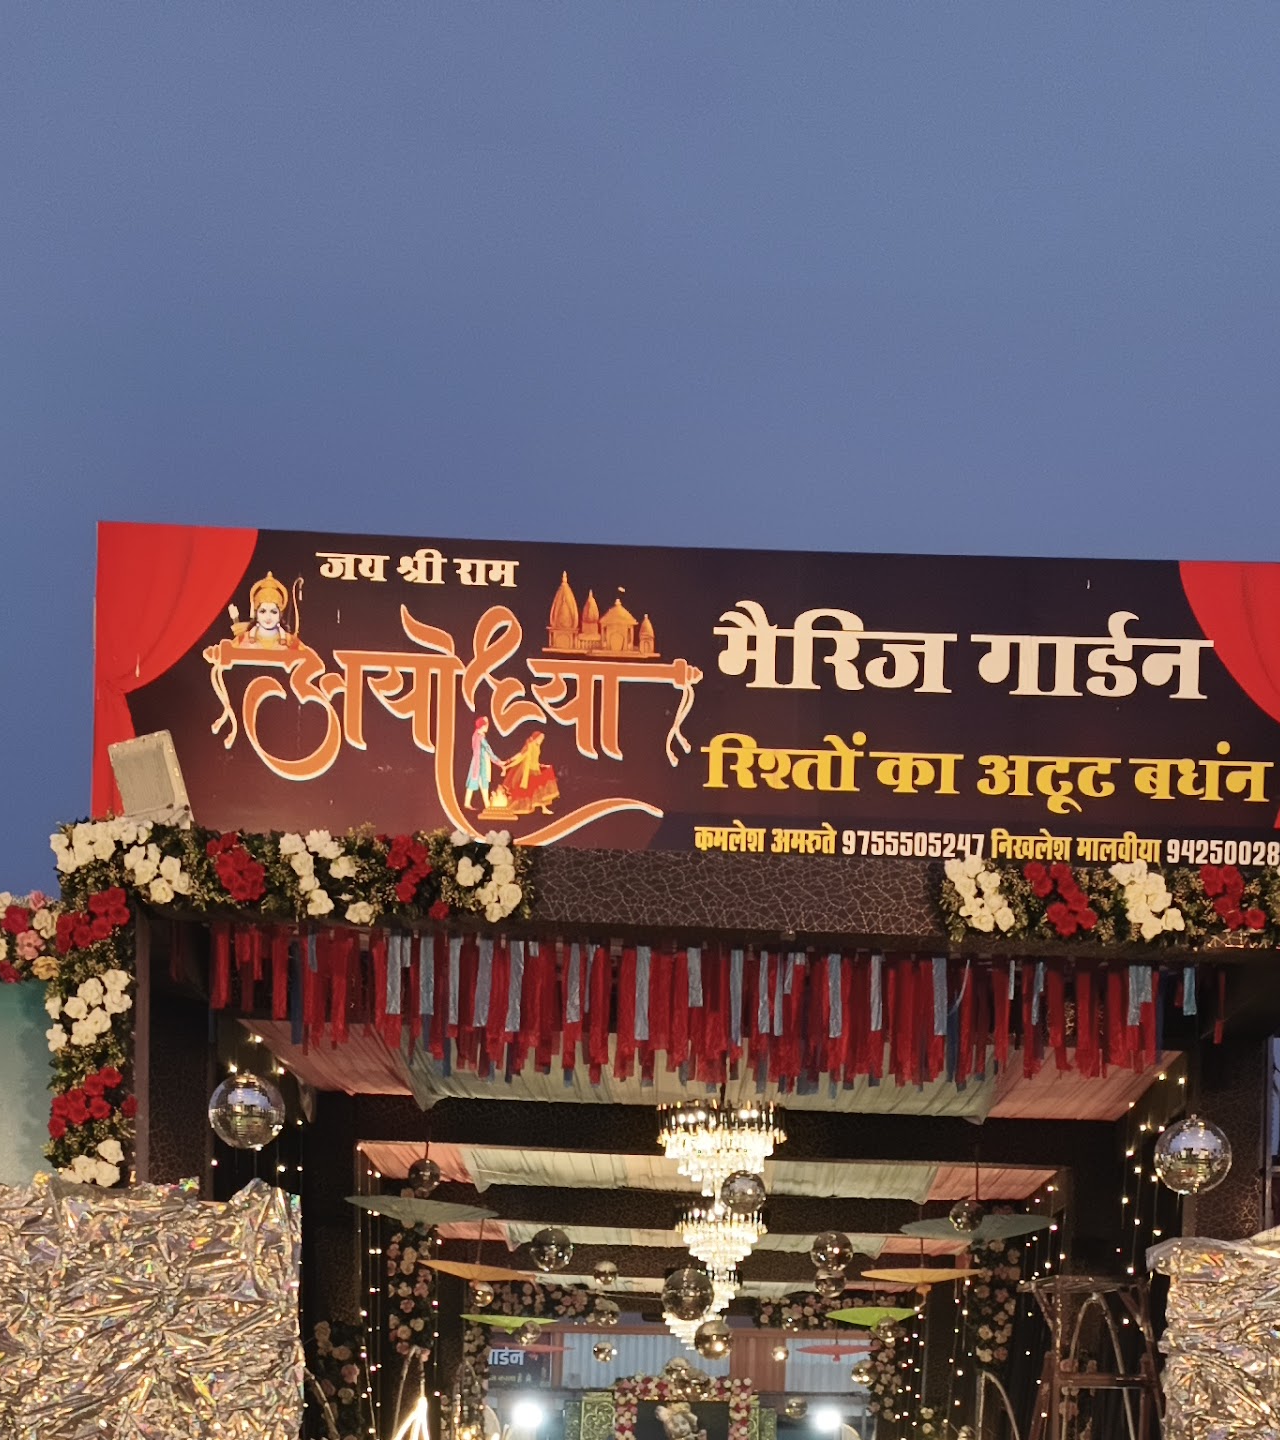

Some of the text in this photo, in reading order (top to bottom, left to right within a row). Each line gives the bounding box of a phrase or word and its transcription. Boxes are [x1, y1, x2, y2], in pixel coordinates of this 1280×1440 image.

[315, 548, 519, 587] जय श्री राम
[713, 600, 1215, 699] मैरिज गार्डन
[204, 603, 704, 846] अयोध्या
[701, 731, 870, 792] रिश्तों
[870, 751, 964, 794] का
[978, 753, 1123, 814] अटूट
[694, 820, 766, 853] कमलेश
[841, 829, 984, 859] 9755505247
[1076, 831, 1162, 863] मालवीया
